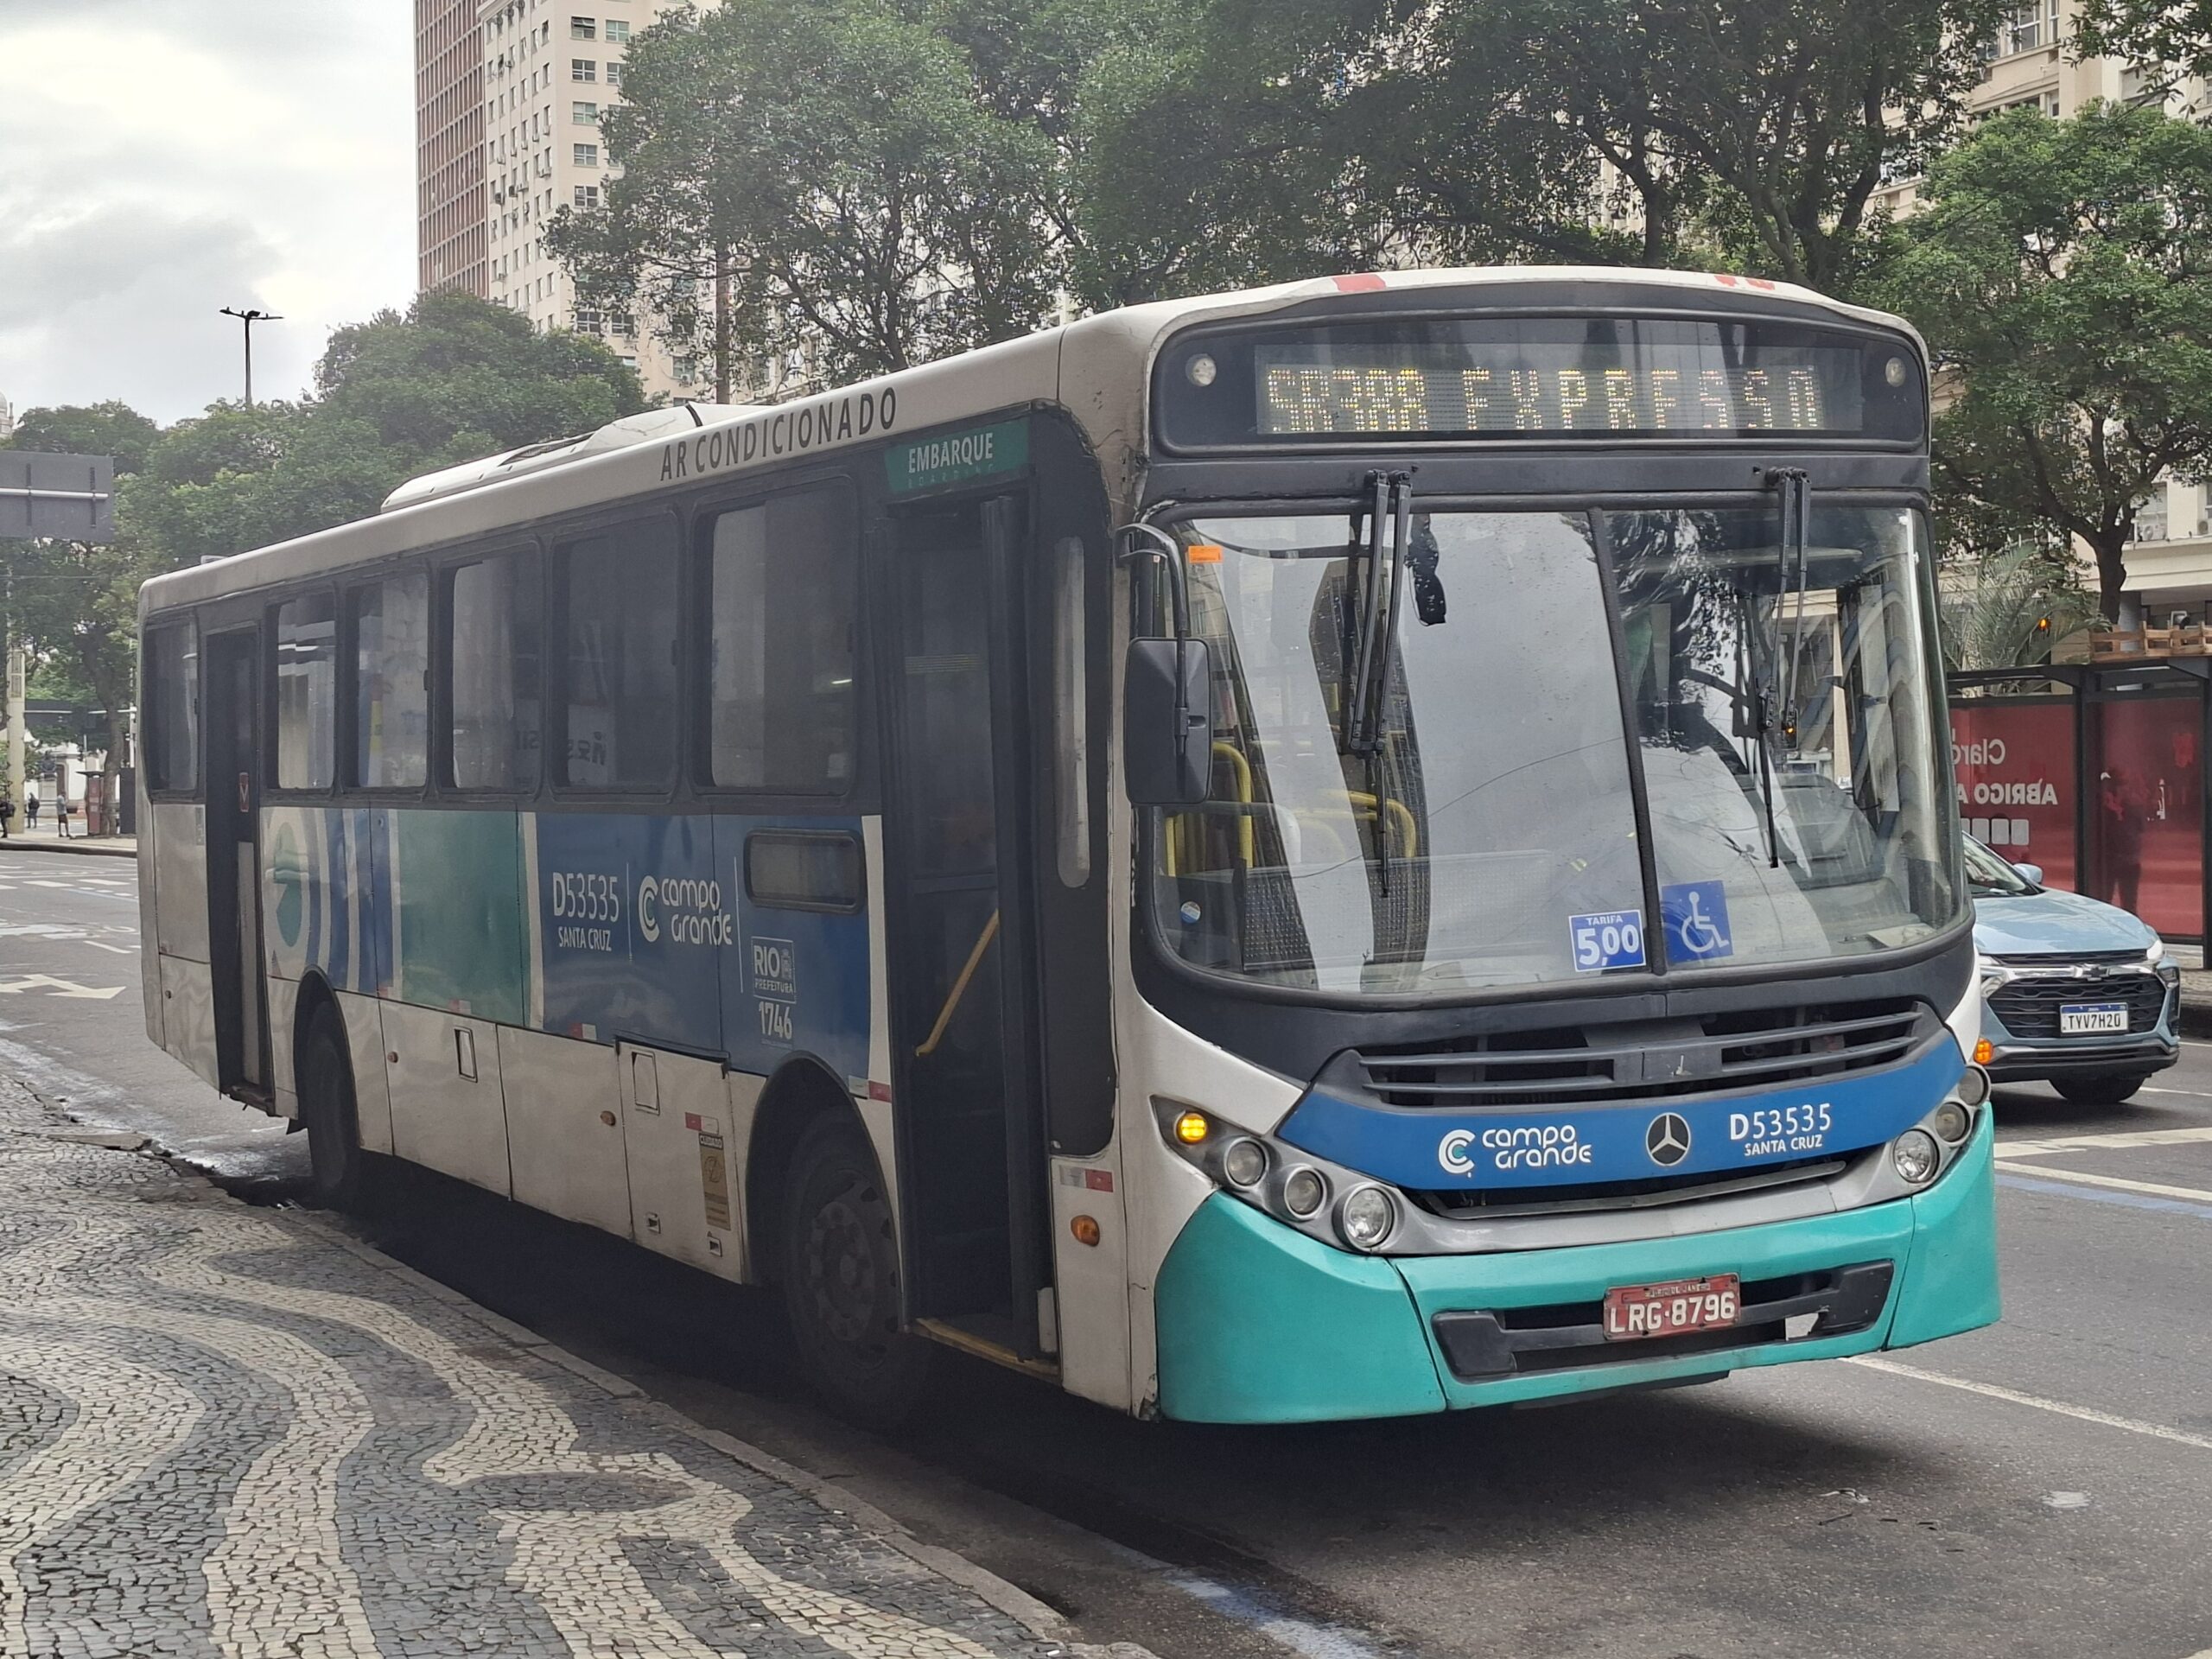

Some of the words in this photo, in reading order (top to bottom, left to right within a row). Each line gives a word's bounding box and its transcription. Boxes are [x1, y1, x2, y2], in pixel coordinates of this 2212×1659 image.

[660, 441, 688, 481] AR
[695, 387, 898, 473] CONDICIONADO
[909, 433, 993, 474] EMBARQUE
[553, 871, 620, 923] D53535
[661, 877, 721, 913] campo
[671, 908, 733, 945] grande
[1586, 914, 1624, 926] TARIFA
[558, 926, 586, 950] SANTA
[588, 928, 612, 951] CRUZ
[1577, 924, 1640, 967] 5,00
[753, 944, 780, 977] RIO
[759, 1001, 792, 1039] 1746
[2068, 1013, 2121, 1031] TYV7H20
[1482, 1124, 1577, 1151] campo
[1730, 1103, 1832, 1141] D53535
[1494, 1141, 1592, 1169] grande
[1744, 1139, 1787, 1156] SANTA
[1790, 1134, 1822, 1152] CRUZ
